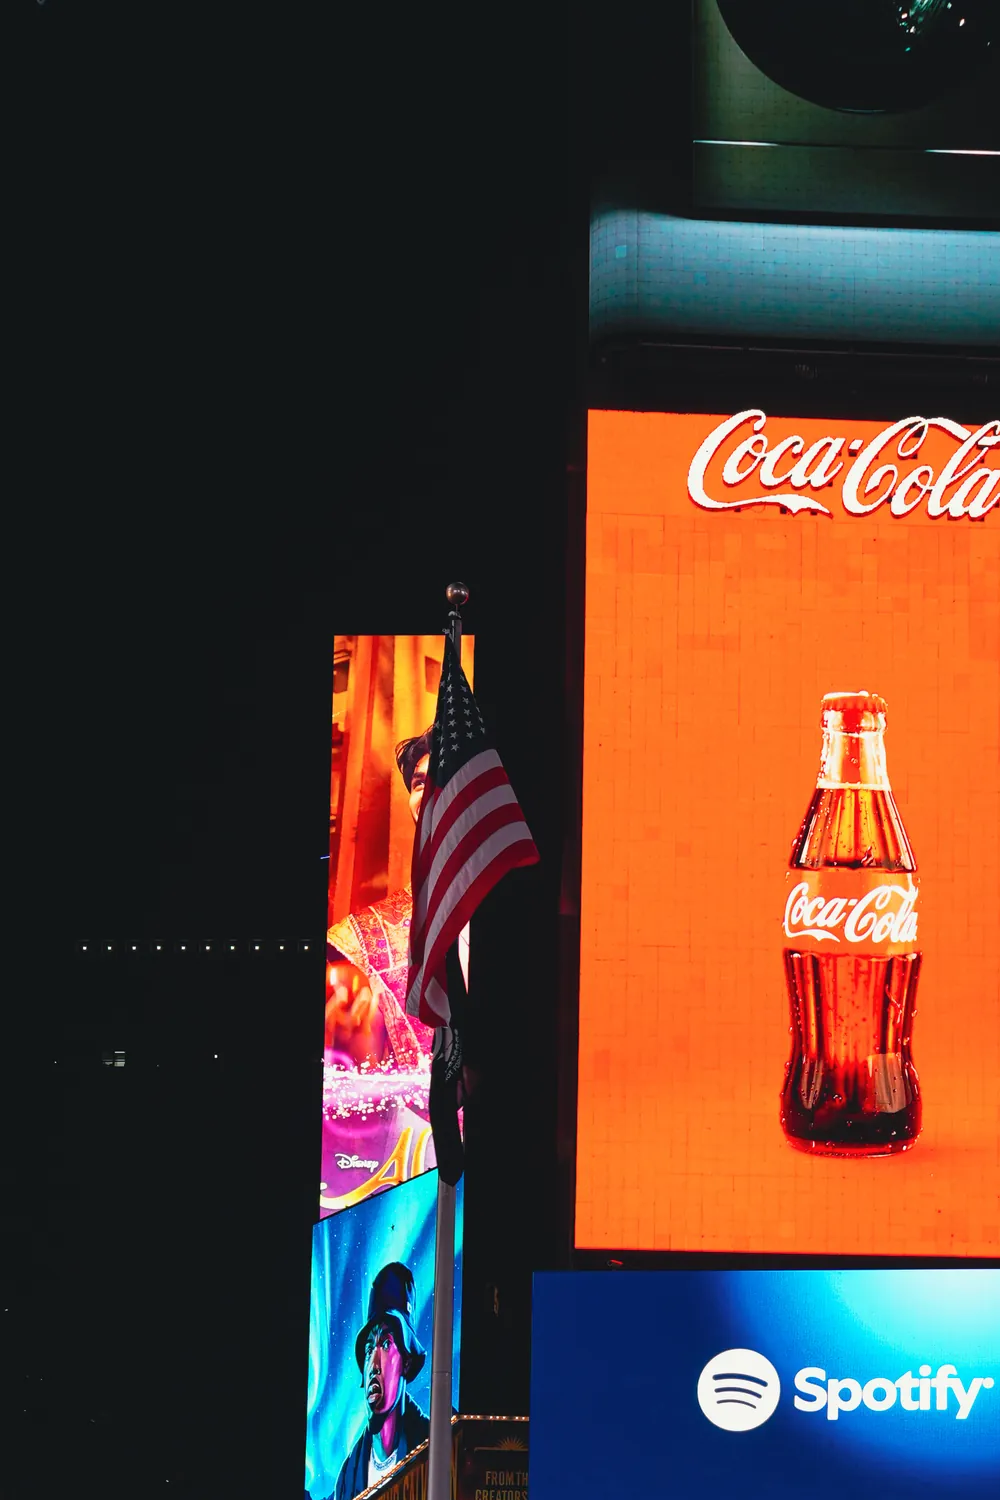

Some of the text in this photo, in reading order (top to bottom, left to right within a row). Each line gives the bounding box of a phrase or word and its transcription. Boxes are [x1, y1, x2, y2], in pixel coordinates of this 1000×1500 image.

[784, 882, 918, 943] Coca-Cola
[335, 1153, 378, 1173] Disney
[794, 1364, 994, 1420] Spotify
[485, 1471, 515, 1486] FROM
